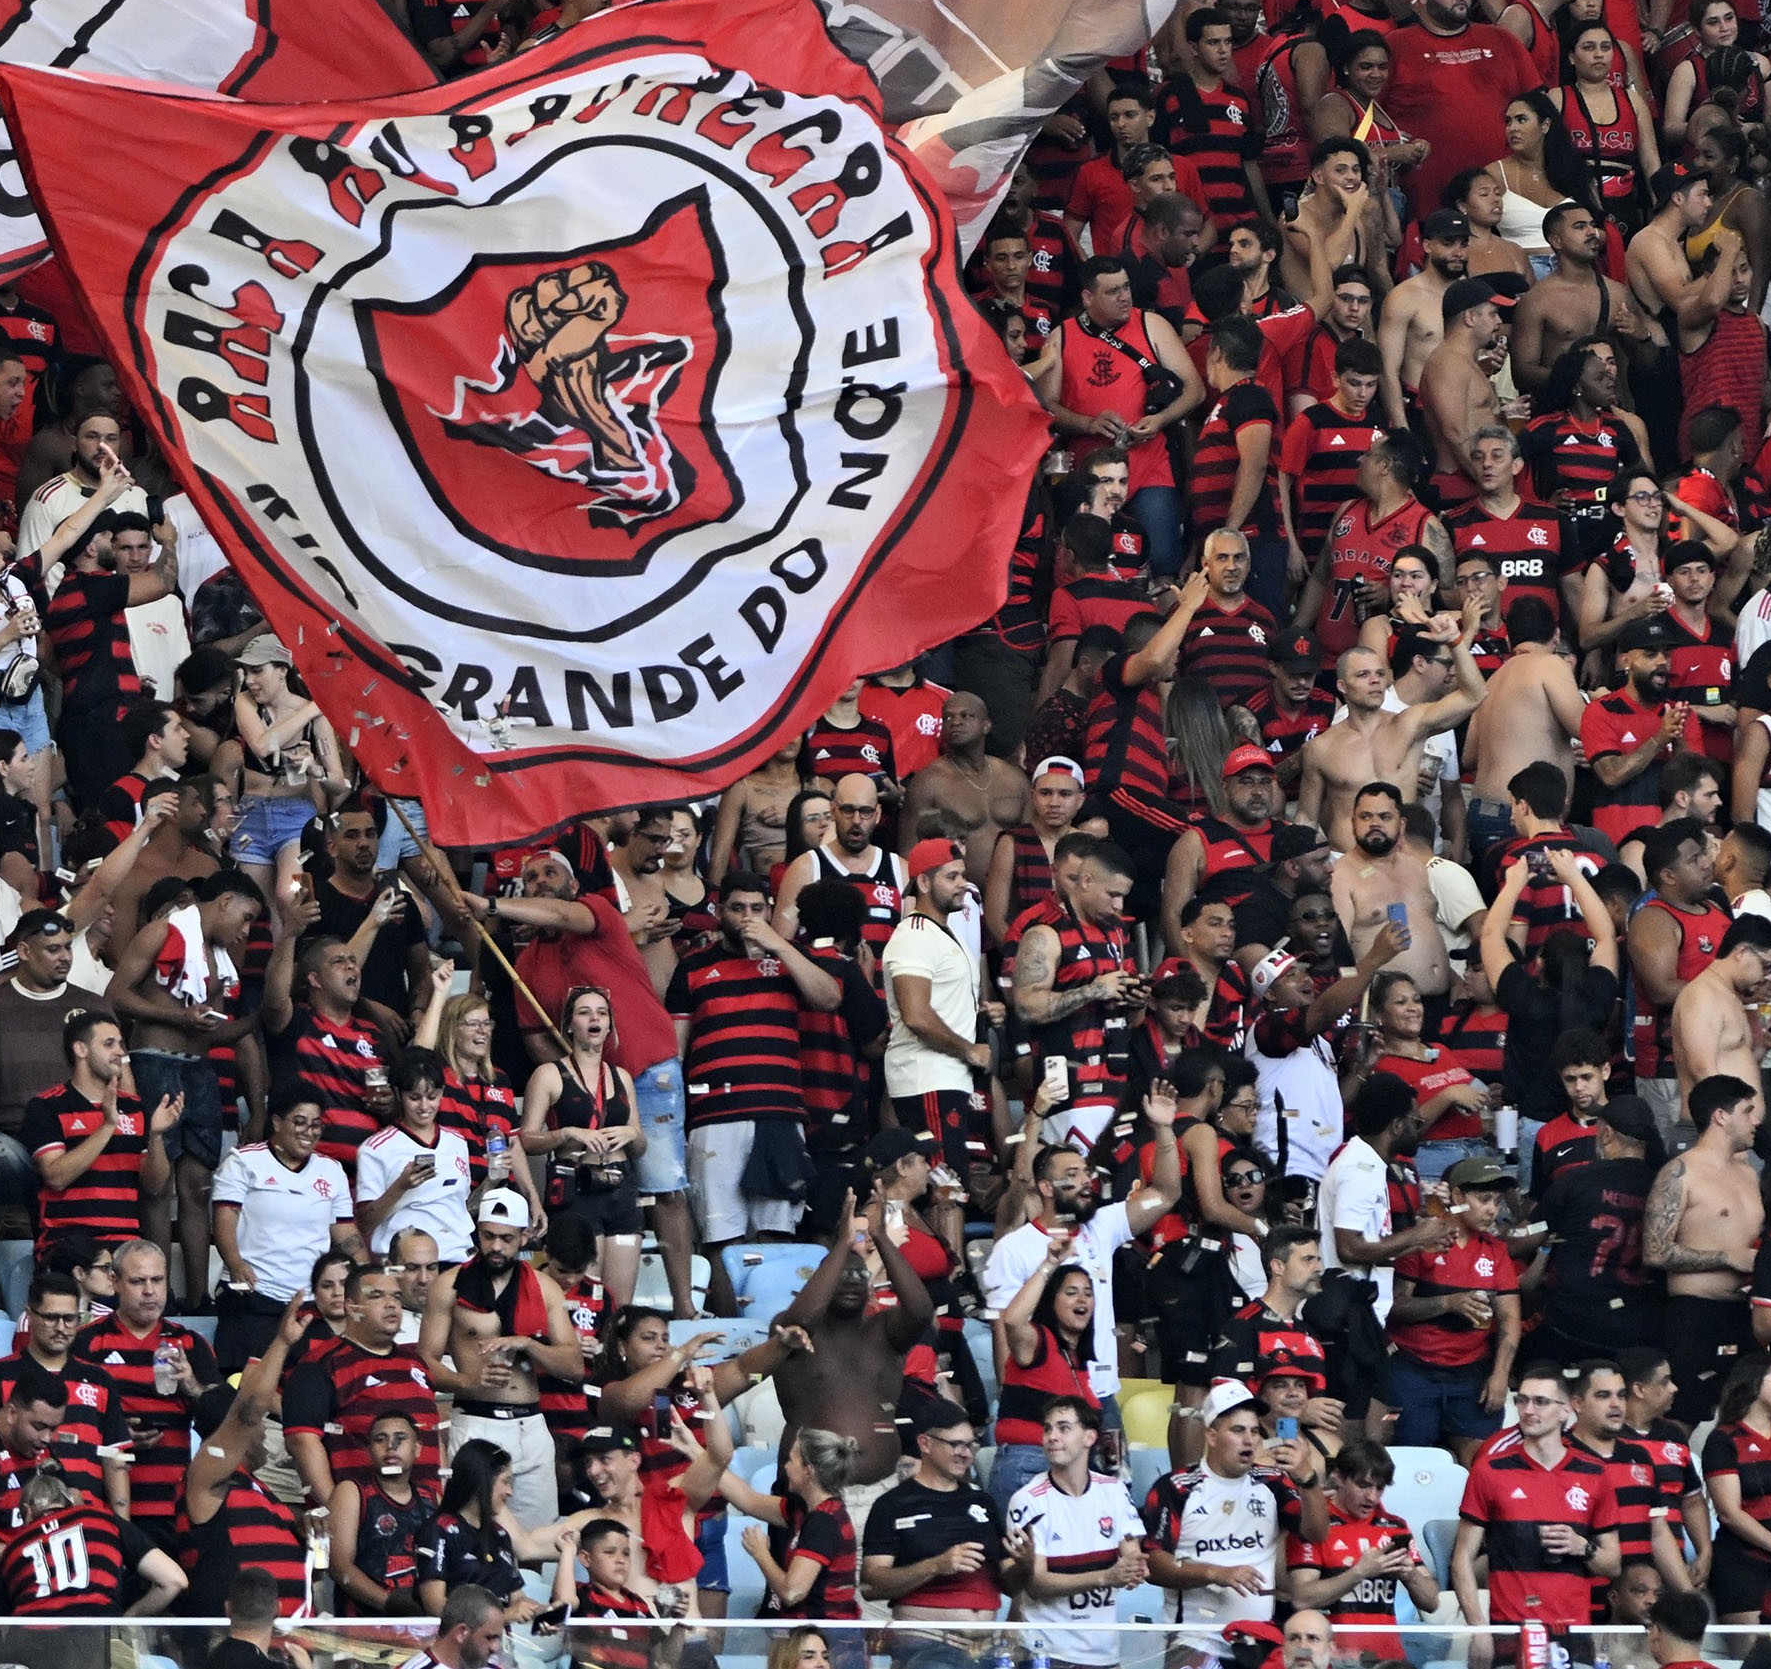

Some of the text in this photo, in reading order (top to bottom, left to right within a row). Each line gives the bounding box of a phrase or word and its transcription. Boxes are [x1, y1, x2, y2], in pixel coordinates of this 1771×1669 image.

[1098, 329, 1123, 351] BOSS
[1501, 559, 1544, 578] BRB
[740, 537, 828, 656] DO
[41, 1519, 60, 1535] LU
[23, 1523, 90, 1599] 10
